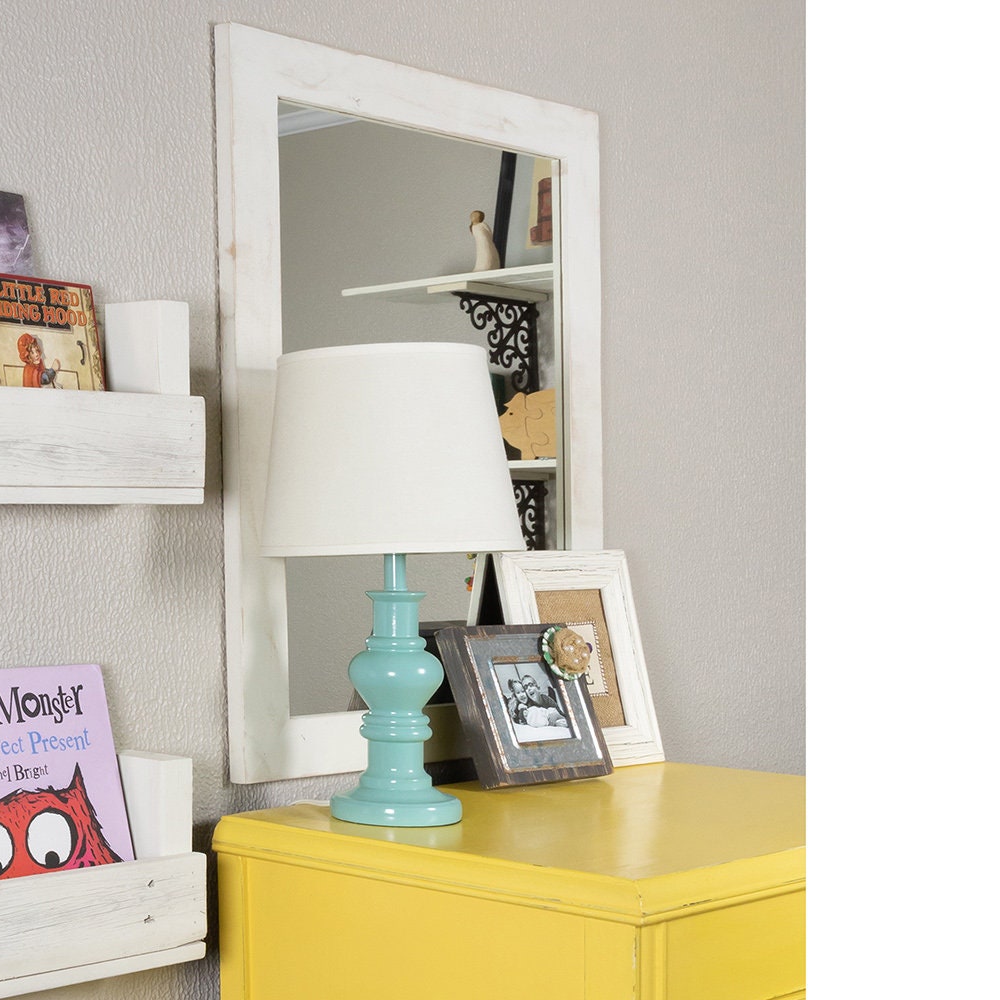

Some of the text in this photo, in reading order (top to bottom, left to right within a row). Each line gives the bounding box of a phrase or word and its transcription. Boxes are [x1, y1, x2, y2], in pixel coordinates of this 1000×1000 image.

[48, 288, 79, 307] RED
[43, 306, 87, 327] HOOD
[27, 727, 91, 755] Present
[15, 763, 49, 781] Bright
